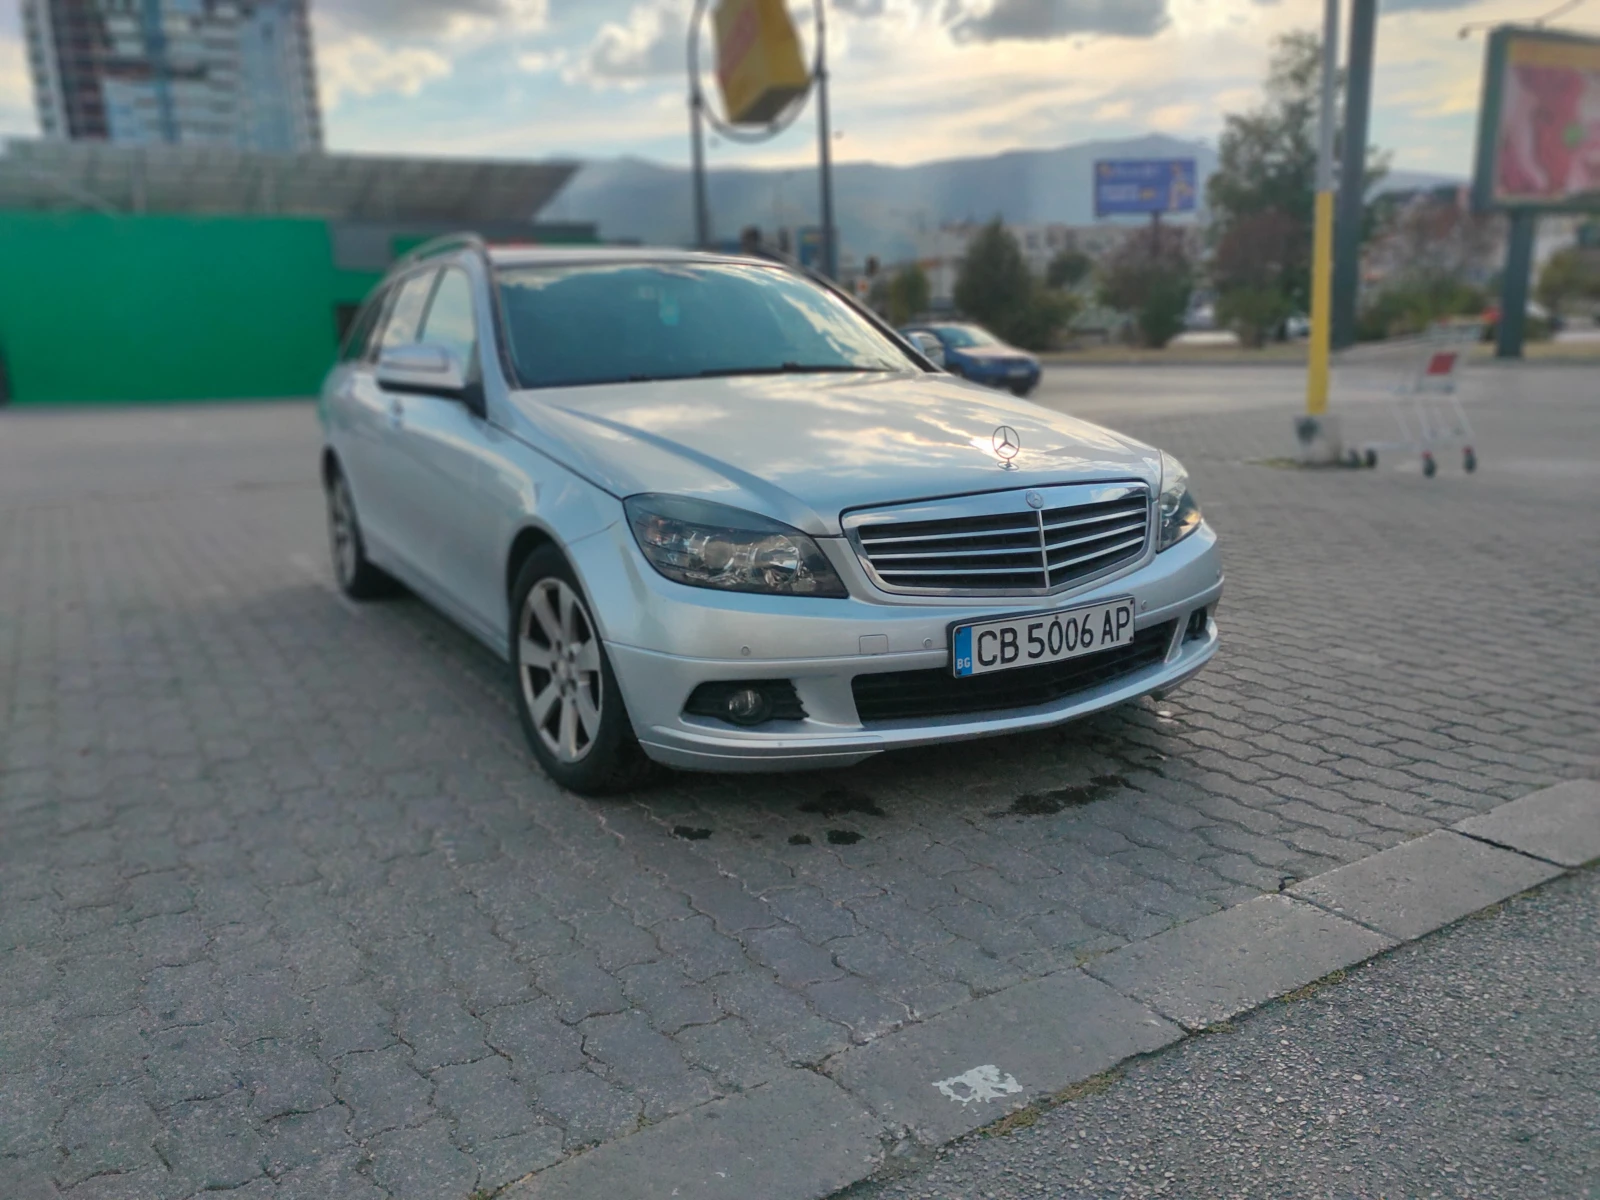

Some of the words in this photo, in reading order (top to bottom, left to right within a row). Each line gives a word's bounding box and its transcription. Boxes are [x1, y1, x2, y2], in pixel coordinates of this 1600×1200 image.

[977, 627, 1019, 667] CB
[1027, 614, 1094, 659] 5006
[1101, 606, 1130, 645] AP
[956, 657, 971, 670] BG
